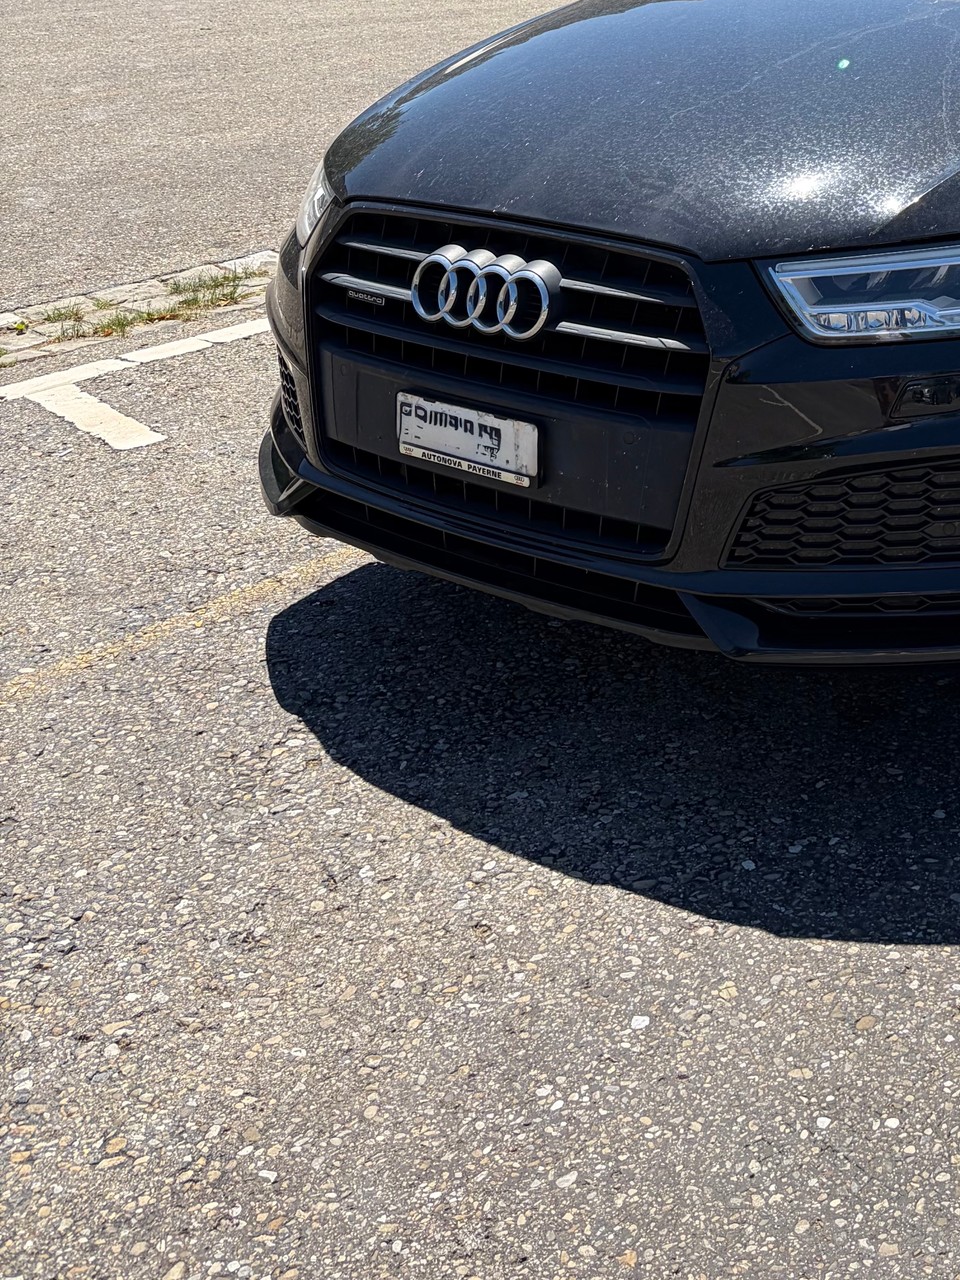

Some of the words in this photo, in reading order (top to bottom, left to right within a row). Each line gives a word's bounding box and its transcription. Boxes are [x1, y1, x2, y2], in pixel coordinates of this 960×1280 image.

[348, 290, 383, 304] quattro
[421, 451, 463, 469] AUTONOVA
[467, 464, 502, 480] PAYERNE
